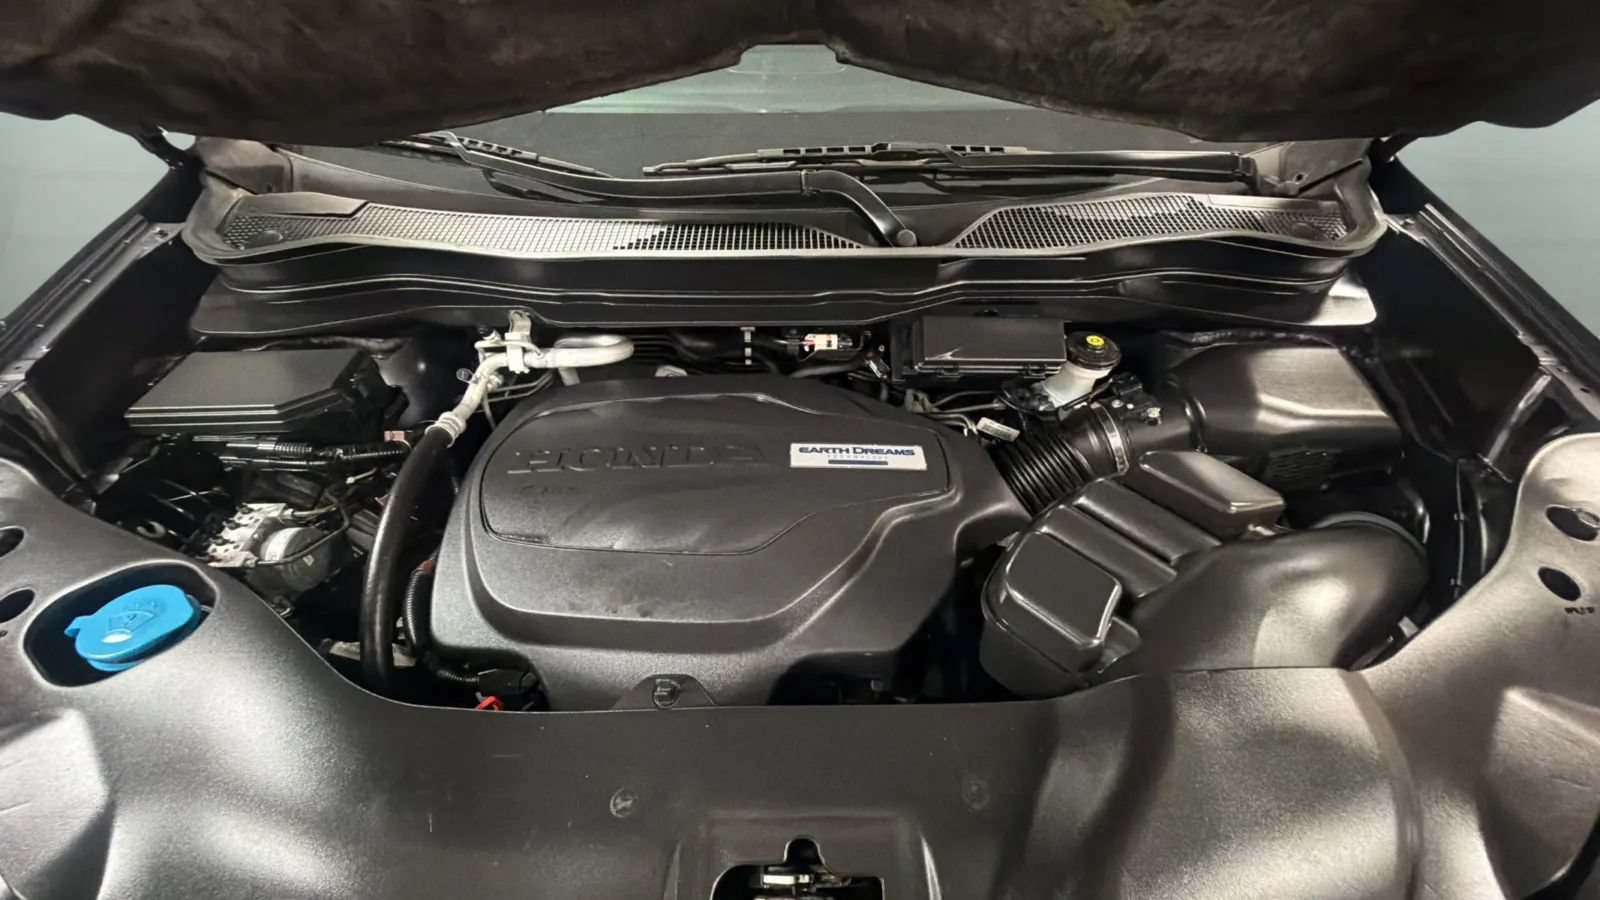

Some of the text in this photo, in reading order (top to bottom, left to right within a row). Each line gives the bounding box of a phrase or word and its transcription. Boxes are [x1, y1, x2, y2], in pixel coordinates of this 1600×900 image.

[507, 444, 769, 475] HONDA
[798, 446, 916, 456] EARTH DREAMS
